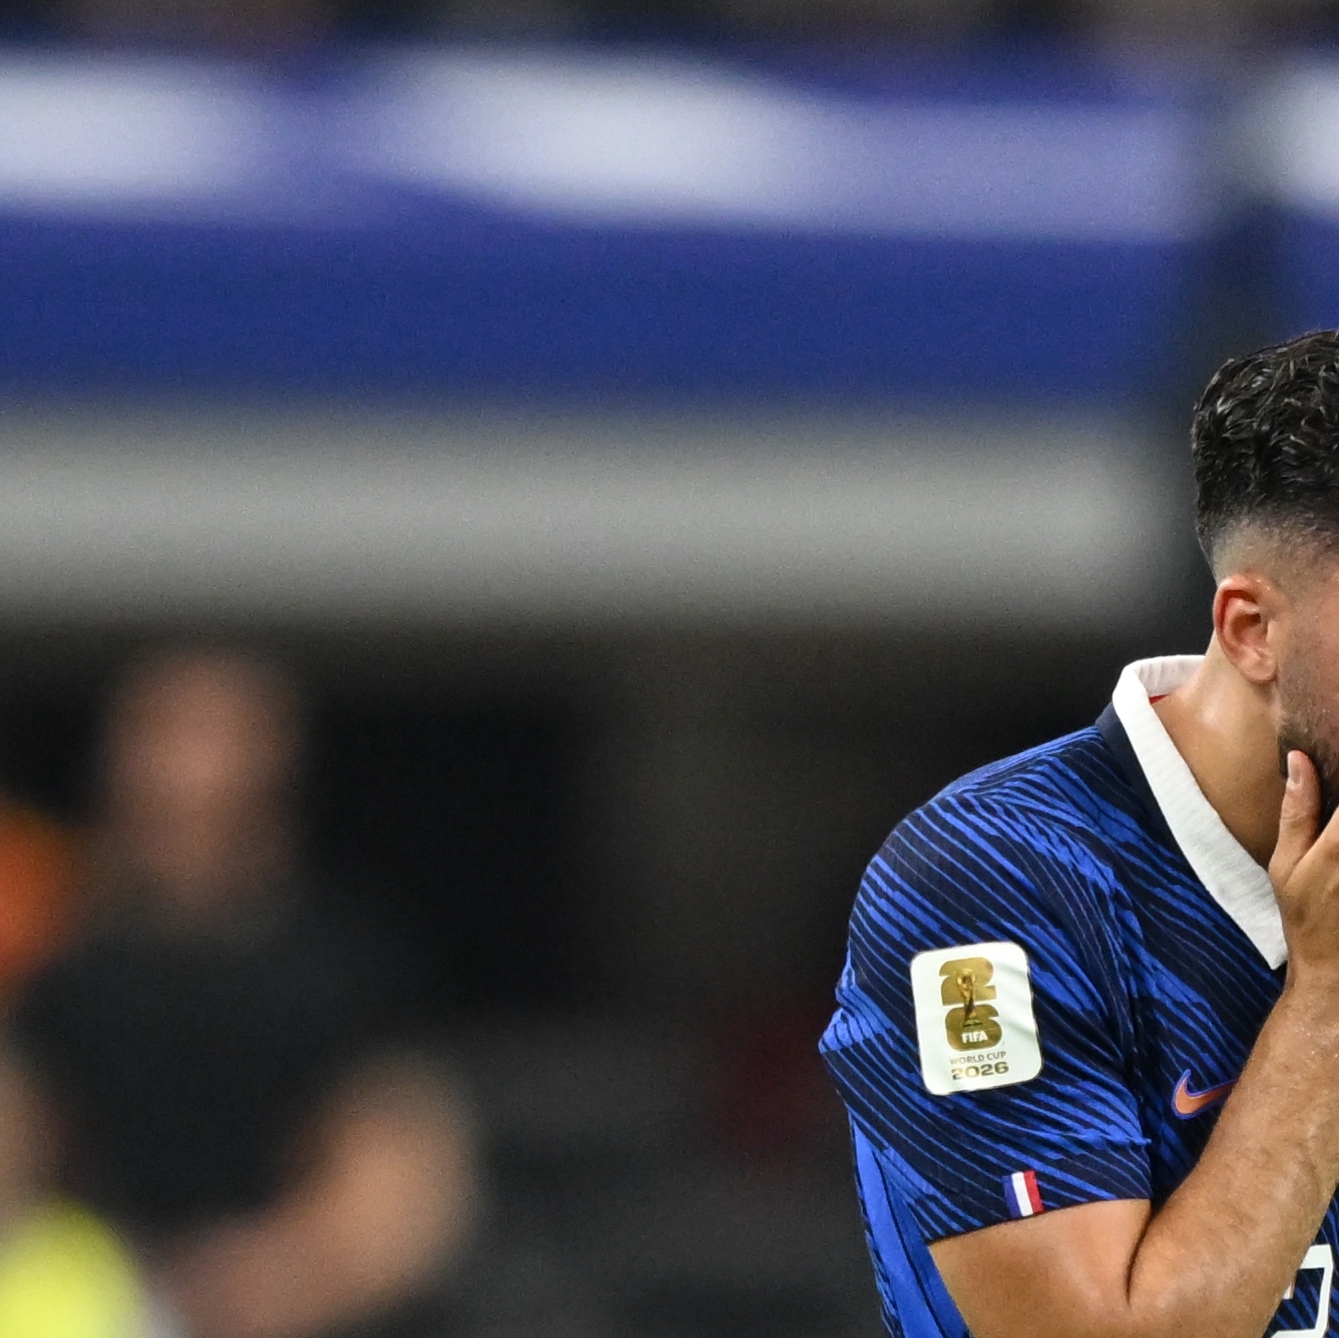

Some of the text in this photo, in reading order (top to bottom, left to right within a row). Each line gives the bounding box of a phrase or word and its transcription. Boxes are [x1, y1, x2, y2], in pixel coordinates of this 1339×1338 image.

[961, 1030, 989, 1044] FIFA
[950, 1051, 1007, 1065] WORLD CUP
[951, 1061, 1010, 1081] 2026
